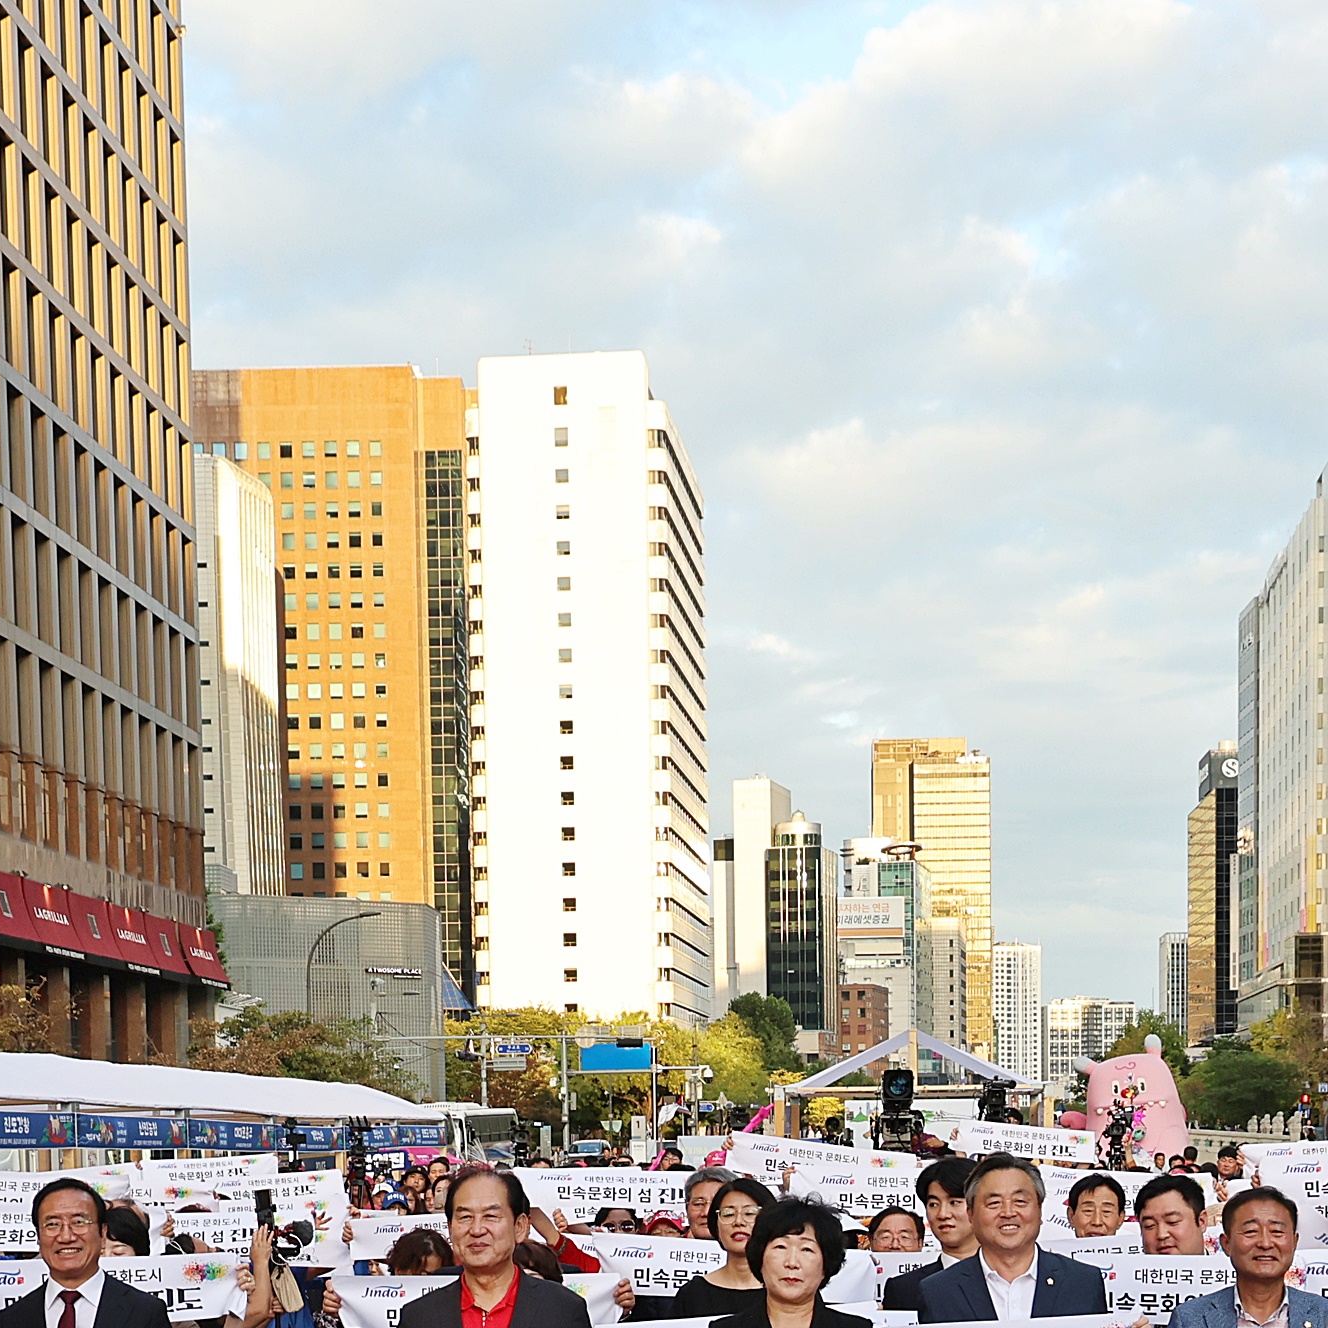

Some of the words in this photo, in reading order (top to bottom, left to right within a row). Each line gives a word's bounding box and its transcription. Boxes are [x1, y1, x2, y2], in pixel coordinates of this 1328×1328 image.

[872, 903, 889, 913] 연금
[982, 1139, 1034, 1154] 민속문화의
[1050, 1144, 1077, 1158] 진도
[867, 1176, 909, 1188] 대한민국
[669, 1250, 721, 1264] 대한민국
[1134, 1267, 1194, 1284] 대한민국
